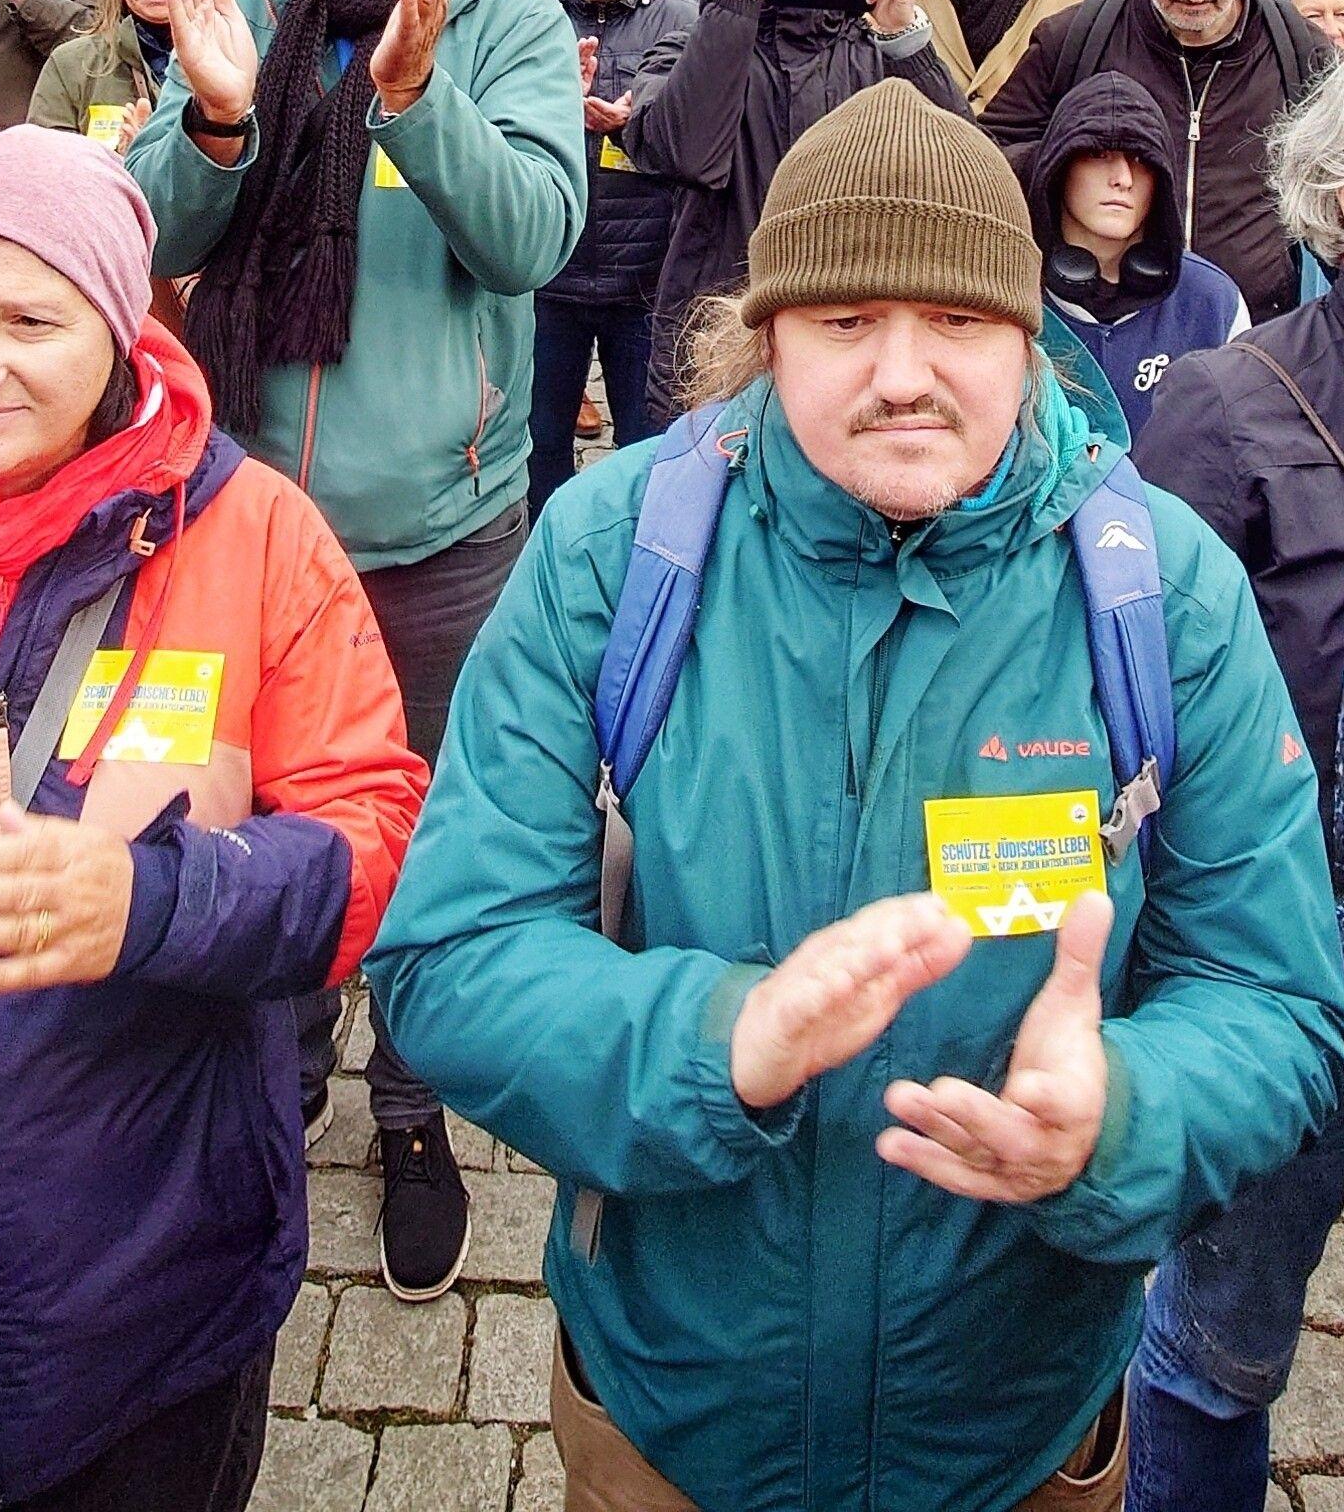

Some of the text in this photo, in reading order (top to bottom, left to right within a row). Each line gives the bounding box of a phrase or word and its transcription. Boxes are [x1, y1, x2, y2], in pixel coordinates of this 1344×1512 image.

[1017, 741, 1091, 758] VAUDE
[942, 835, 1091, 861] SCHÜTZE JÜDISCHES LEBEN
